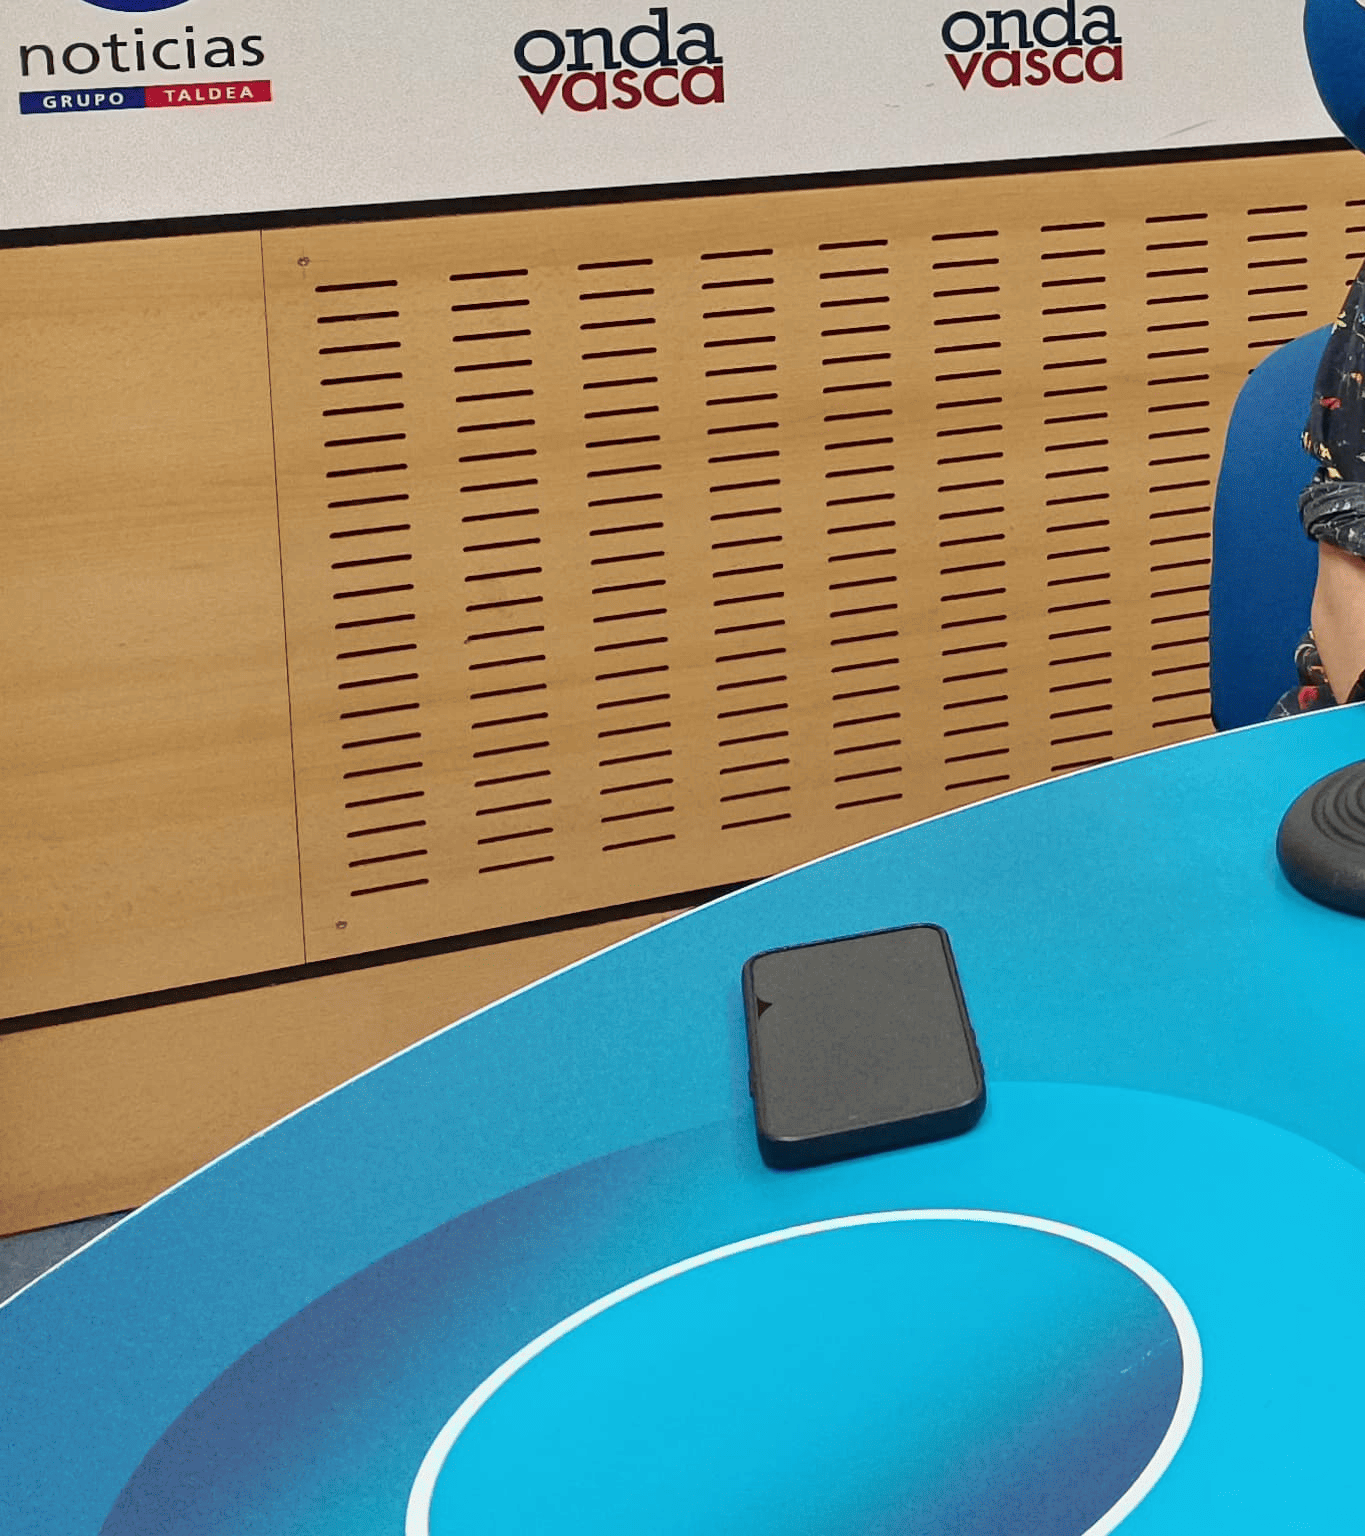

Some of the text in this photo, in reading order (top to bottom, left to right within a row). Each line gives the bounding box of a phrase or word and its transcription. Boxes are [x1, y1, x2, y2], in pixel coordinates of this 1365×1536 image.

[20, 26, 264, 76] noticias
[514, 7, 724, 69] onda
[519, 66, 724, 114] vasca
[945, 46, 1123, 89] vasca
[42, 83, 255, 110] GRUPO TALDEA
